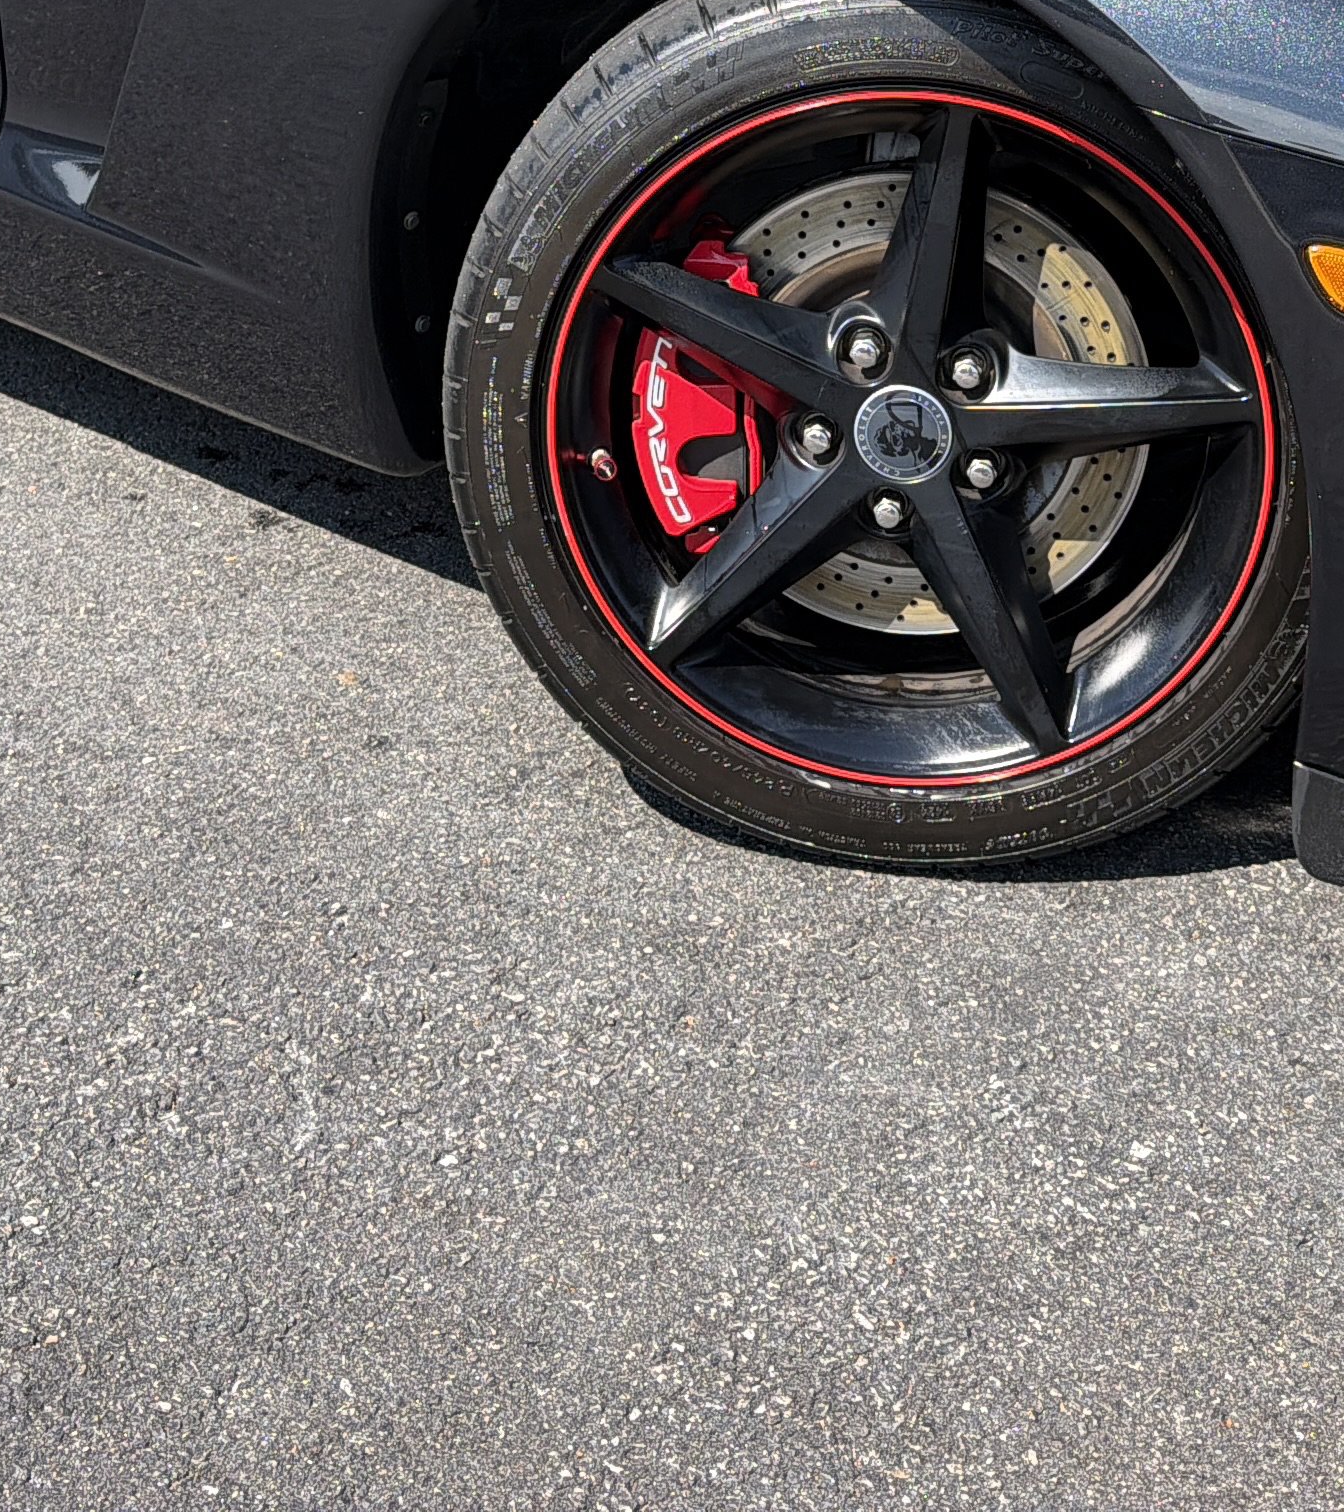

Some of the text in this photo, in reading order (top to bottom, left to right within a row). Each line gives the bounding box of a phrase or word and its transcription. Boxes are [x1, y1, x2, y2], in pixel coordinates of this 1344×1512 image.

[647, 336, 692, 524] CORVETT
[859, 407, 900, 476] CHEVROLET
[1136, 658, 1282, 797] MICHELIN
